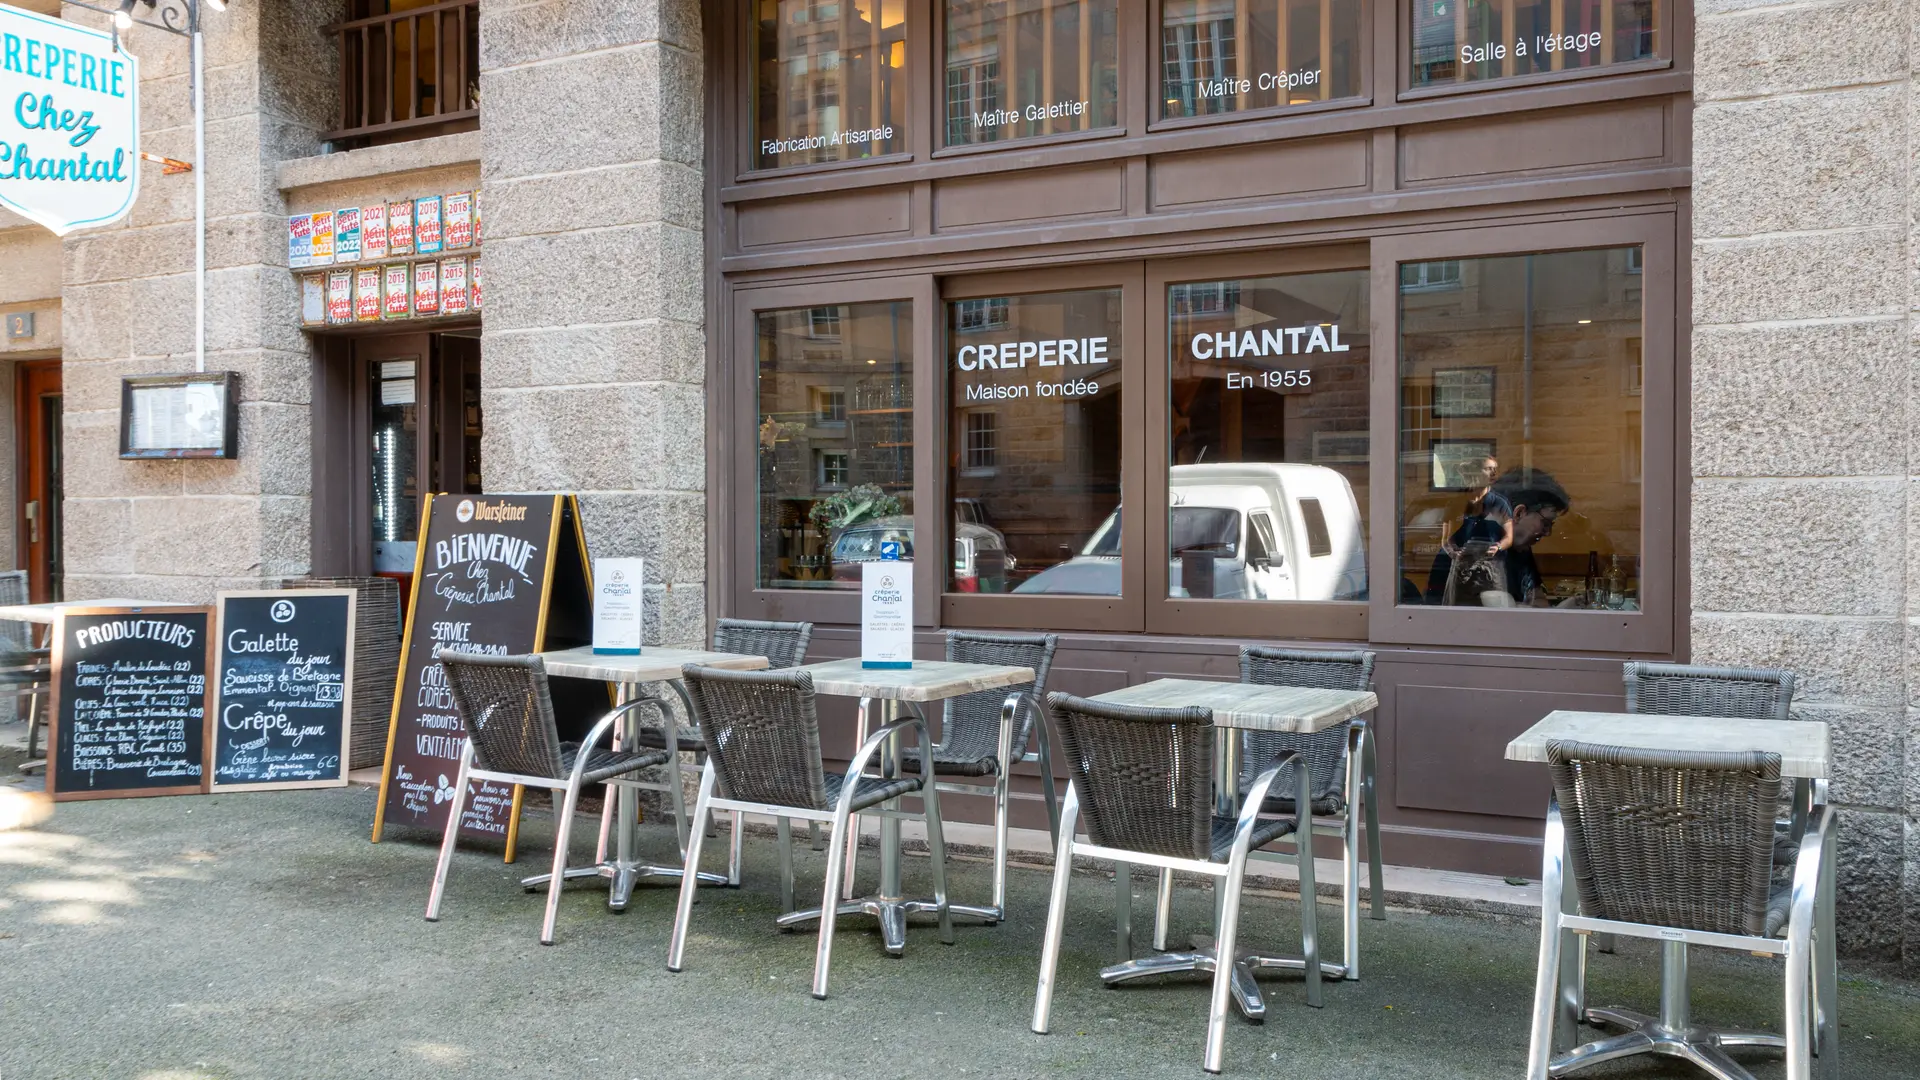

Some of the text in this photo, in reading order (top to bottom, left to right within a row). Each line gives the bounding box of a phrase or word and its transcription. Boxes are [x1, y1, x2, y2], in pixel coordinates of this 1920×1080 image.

[1461, 30, 1601, 64] Salle à l'étage
[0, 32, 125, 98] REPERIE
[1199, 67, 1322, 99] Maître Crêpier
[15, 92, 101, 147] Chez
[974, 99, 1088, 128] Maître Galettier
[762, 125, 893, 155] Fabrication Artisanale
[364, 207, 384, 221] 2021
[390, 204, 411, 217] 2020
[419, 202, 438, 215] 2019
[449, 202, 468, 214] 2018
[337, 240, 360, 252] 2022
[388, 273, 405, 284] 2013
[418, 271, 435, 282] 2014
[445, 267, 463, 279] 2015
[331, 280, 348, 290] 2011
[360, 277, 377, 288] 2012
[15, 317, 24, 334] 2
[1191, 324, 1350, 360] CHANTAL
[958, 336, 1108, 371] CREPERIE
[1227, 369, 1311, 389] En 1955
[966, 379, 1099, 400] Maison fondée
[475, 500, 527, 523] Warsteiner
[467, 560, 489, 580] Chez
[435, 572, 515, 611] Crêperie Chantal
[872, 595, 902, 603] Chantal
[75, 619, 196, 649] PRODUCTEURS
[227, 629, 299, 653] Galette
[173, 660, 191, 672] (22)
[286, 652, 331, 673] du jour
[189, 674, 205, 685] (22)
[224, 667, 341, 686] Saucisse de Bretagne
[186, 684, 204, 694] (22)
[170, 695, 189, 707] (22)
[189, 707, 204, 719] (22)
[223, 703, 287, 738] Crêpe
[166, 719, 184, 731] (22)
[167, 729, 185, 741] (22)
[281, 722, 326, 747] du jour
[167, 741, 187, 753] (35)
[417, 734, 445, 757] VENTE
[231, 750, 258, 767] Crêpe
